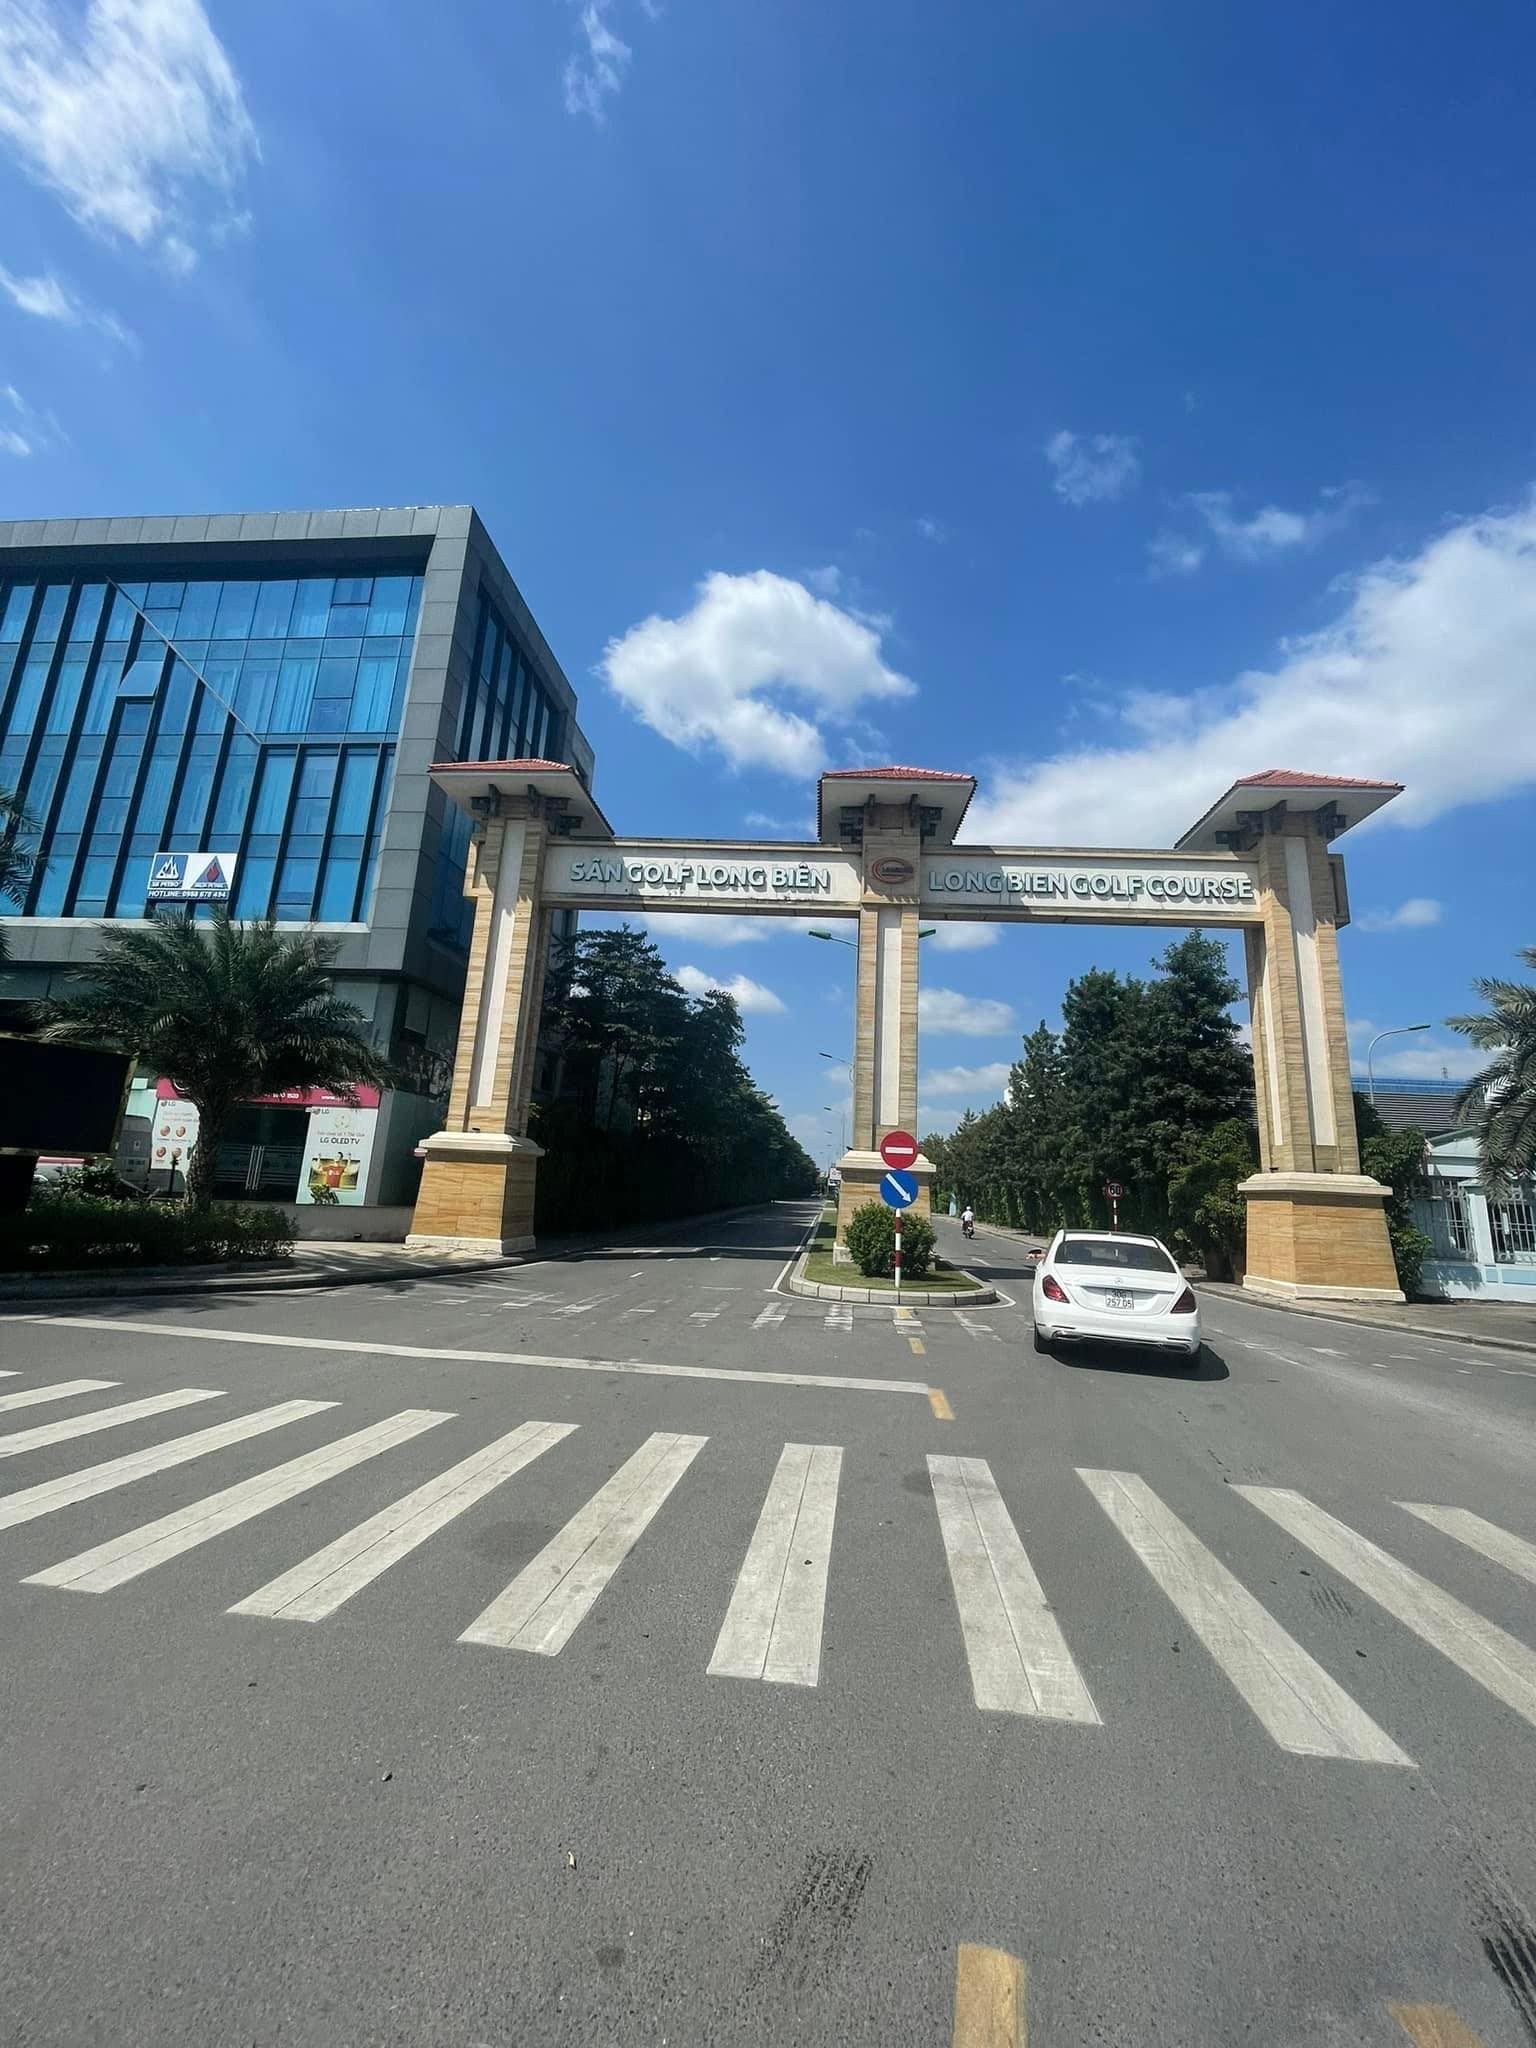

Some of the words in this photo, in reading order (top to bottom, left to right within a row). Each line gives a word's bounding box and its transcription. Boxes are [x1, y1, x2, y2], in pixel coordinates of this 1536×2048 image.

[628, 862, 692, 884] GOLF
[697, 864, 764, 887] LONG
[772, 861, 829, 888] BIÊN
[928, 870, 1003, 893] LONG
[1007, 872, 1067, 894] BIEN
[1070, 873, 1142, 897] GOLF
[1146, 876, 1255, 900] COURSE
[1110, 1184, 1121, 1195] 60
